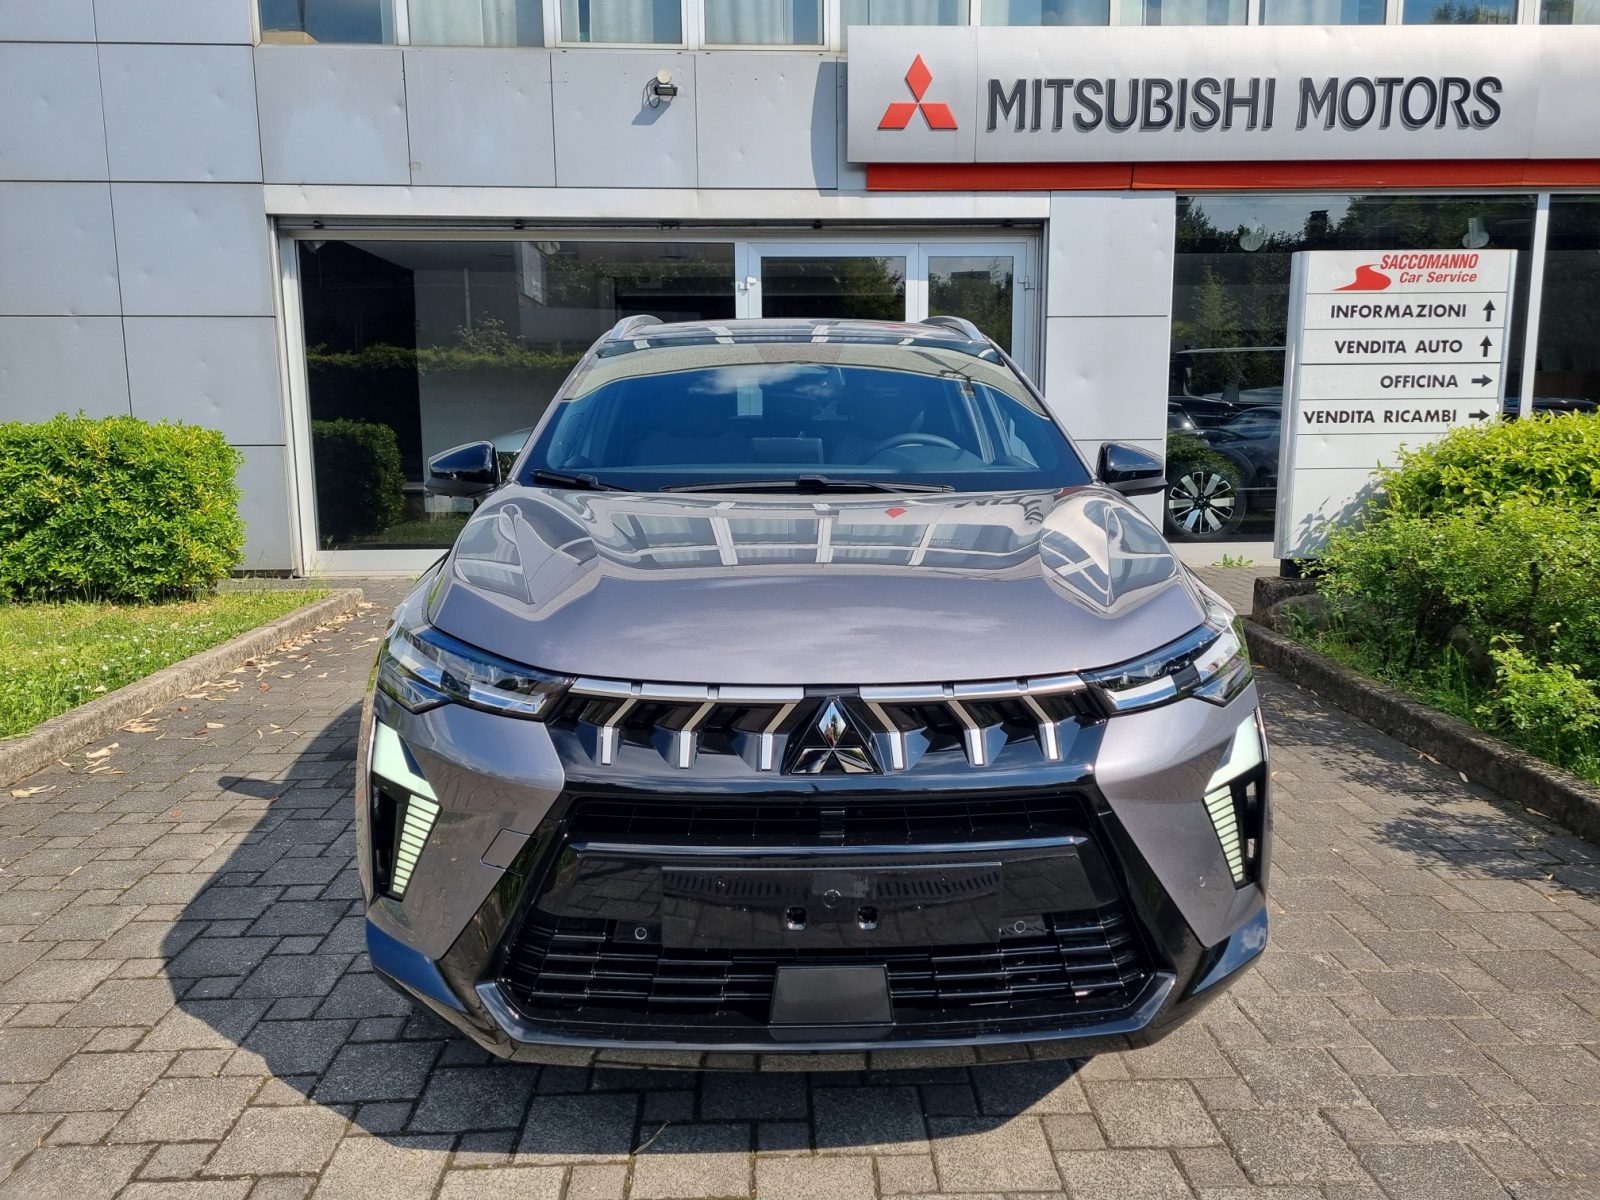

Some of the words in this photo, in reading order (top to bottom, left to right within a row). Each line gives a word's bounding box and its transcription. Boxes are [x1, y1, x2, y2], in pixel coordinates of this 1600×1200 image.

[986, 77, 1276, 131] MITSUBISHI
[1296, 76, 1503, 131] MOTORS
[1380, 253, 1479, 270] SACCOMANNO
[1400, 272, 1421, 283] Car
[1426, 271, 1478, 283] Service
[1330, 304, 1467, 319] INFORMAZIONI
[1335, 340, 1407, 354] VENDITA
[1415, 340, 1463, 353] AUTO
[1380, 375, 1459, 388] OFFICINA
[1304, 410, 1376, 424] VENDITA
[1384, 409, 1457, 423] RICAMBI
